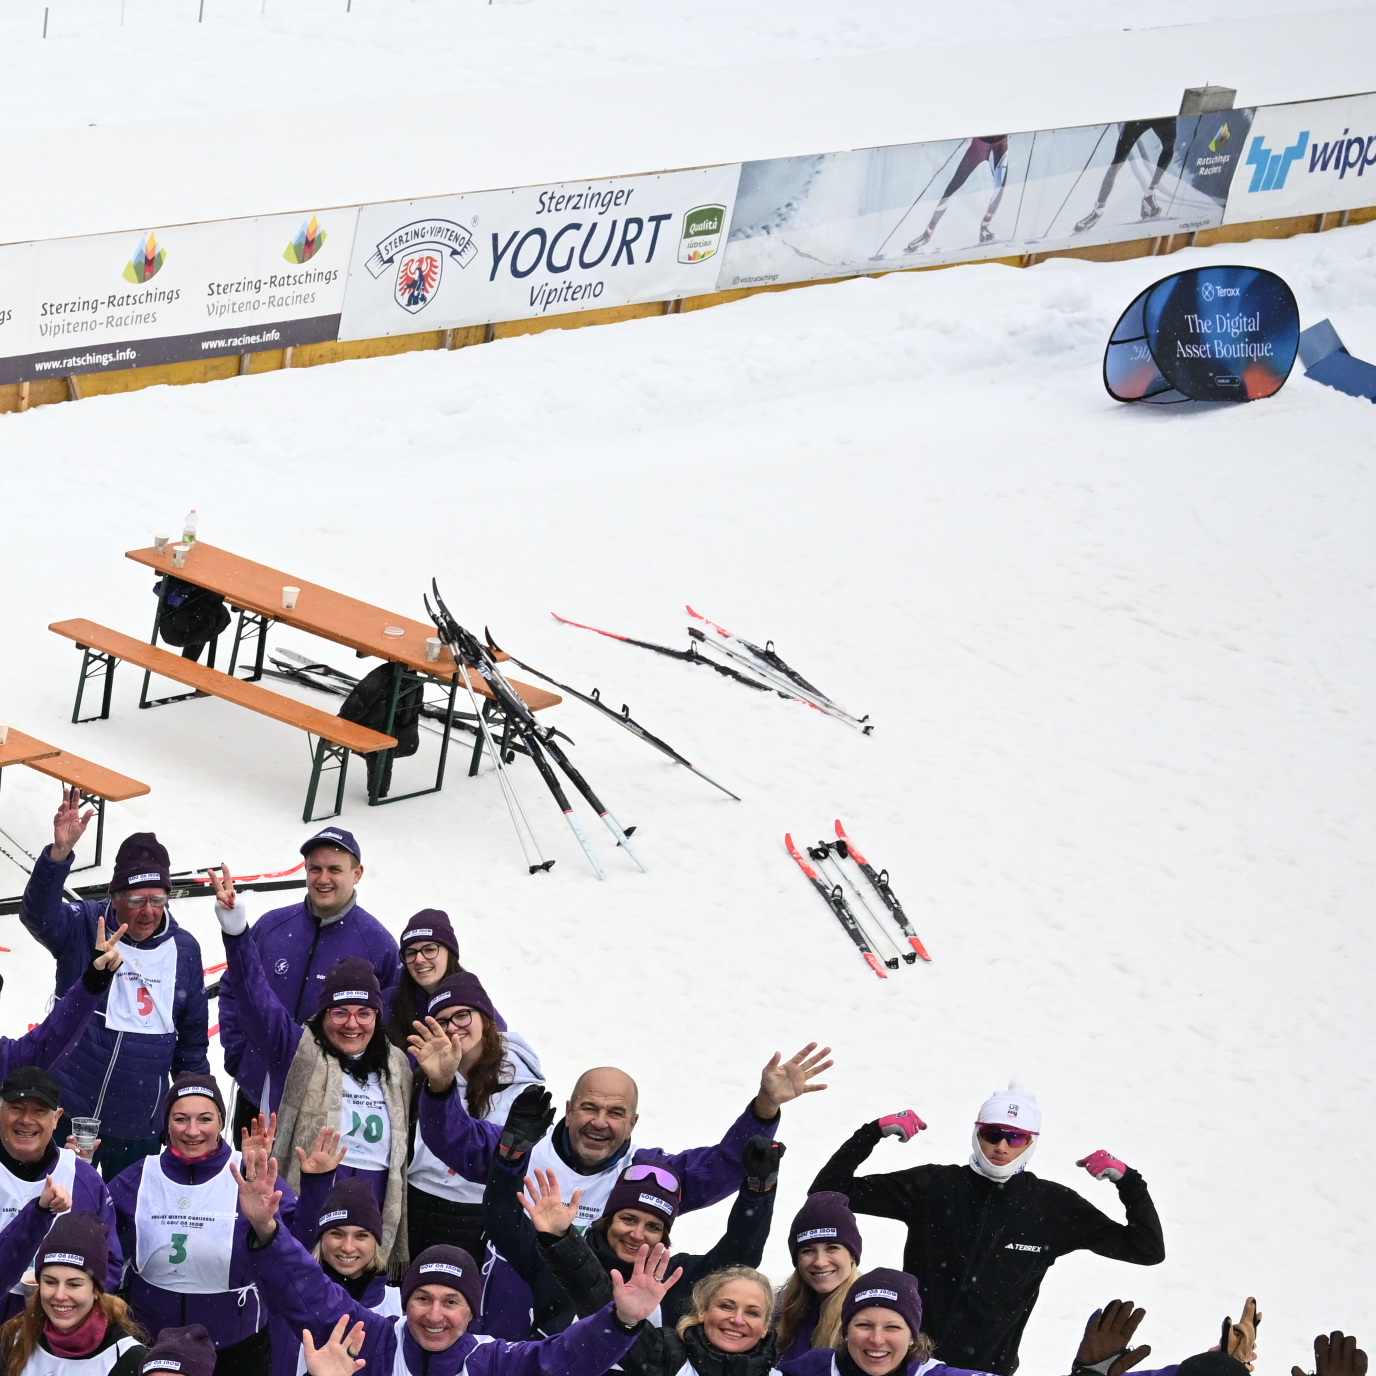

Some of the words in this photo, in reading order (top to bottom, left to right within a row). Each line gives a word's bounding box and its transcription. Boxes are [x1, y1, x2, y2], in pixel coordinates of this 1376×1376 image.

[535, 185, 634, 216] Sterzinger
[488, 213, 673, 282] YOGURT
[207, 267, 339, 297] Sterzing-Ratschings
[529, 277, 605, 313] Vipiteno
[40, 287, 182, 317] Sterzing-Ratschings
[206, 290, 316, 318] Vipiteno-Racines
[39, 310, 158, 338] Vipiteno-Racines
[1184, 314, 1212, 334] The
[1216, 311, 1261, 338] Digital
[201, 328, 281, 350] www.racines.info
[1176, 339, 1210, 359] Asset
[1214, 338, 1274, 362] Boutique.
[35, 347, 137, 372] www.ratschings.info
[136, 986, 154, 1017] 5
[169, 1233, 189, 1265] 3
[1014, 1243, 1042, 1253] TERREX
